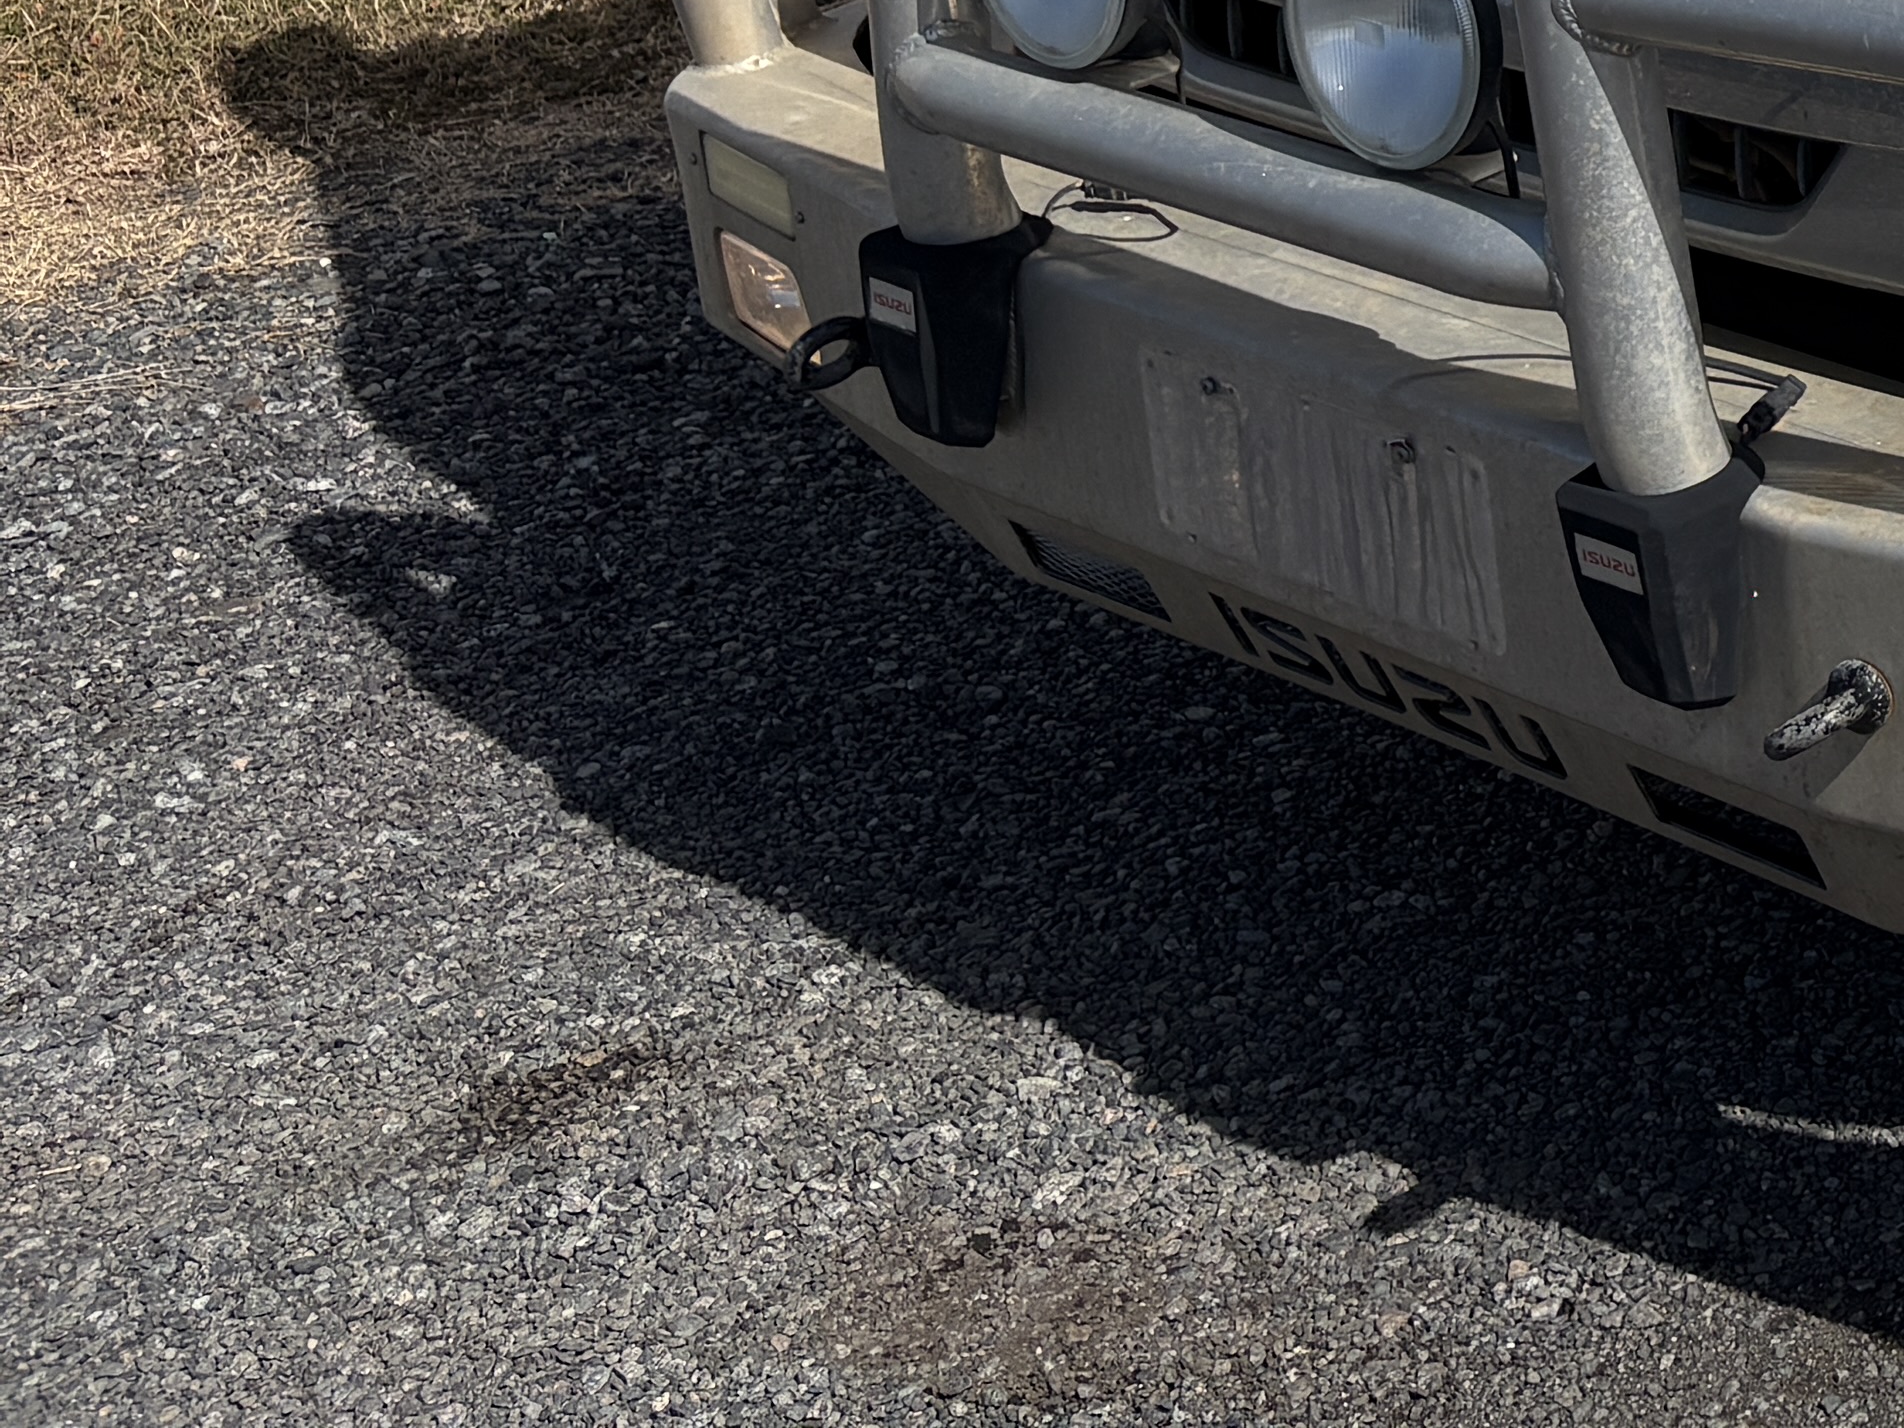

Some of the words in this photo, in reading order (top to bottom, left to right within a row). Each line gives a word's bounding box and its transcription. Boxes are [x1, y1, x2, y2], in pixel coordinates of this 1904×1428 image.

[873, 292, 913, 316] ISUZU
[1581, 548, 1637, 578] ISUZU
[1207, 591, 1568, 781] ISUZU
